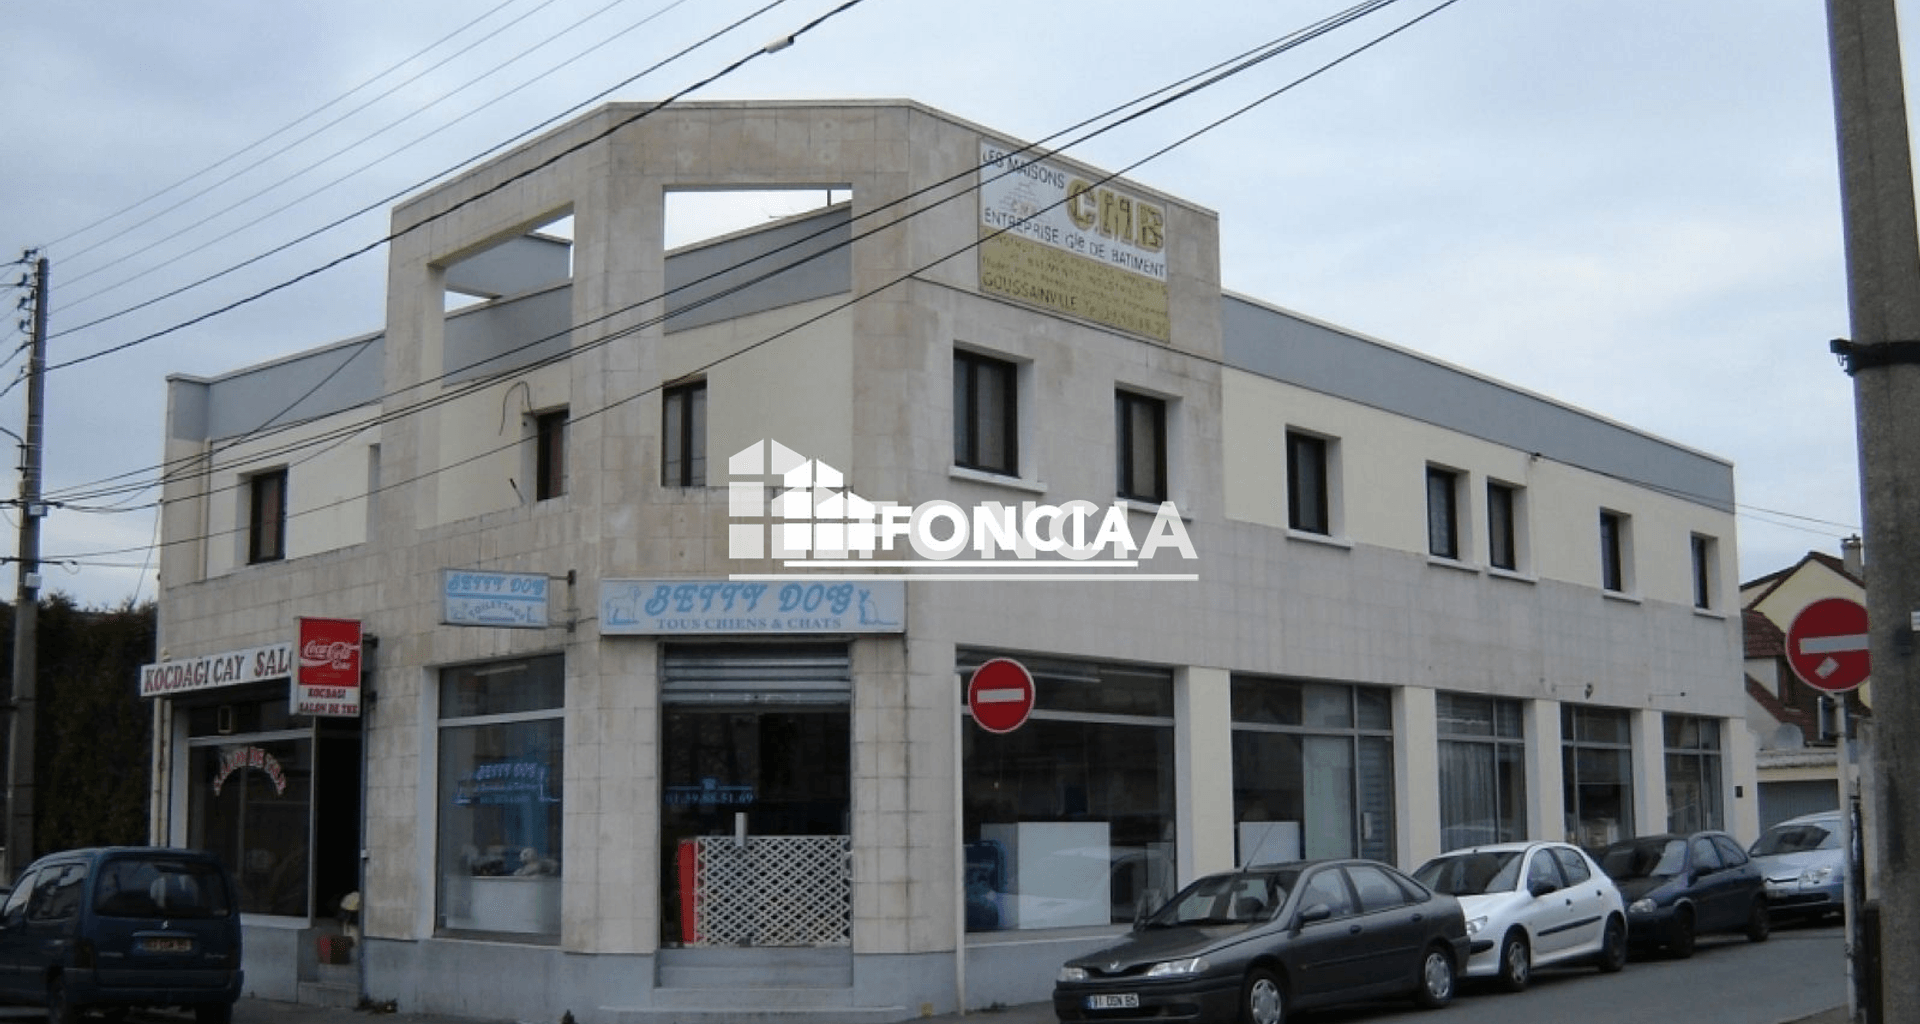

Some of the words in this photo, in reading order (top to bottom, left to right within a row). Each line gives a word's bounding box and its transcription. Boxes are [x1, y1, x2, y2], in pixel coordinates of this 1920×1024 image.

[1008, 157, 1065, 189] MAISONS
[984, 207, 1059, 243] ENTREPRISE
[1090, 242, 1105, 258] DE
[983, 276, 1076, 310] GOUSSAINVILLE
[447, 573, 506, 591] BETTY
[510, 577, 546, 595] DOG
[645, 583, 768, 616] BETTY
[778, 583, 854, 616] DOG
[656, 618, 703, 630] TOUS
[705, 618, 768, 630] CHIENS
[771, 618, 784, 629] &
[787, 617, 841, 629] CHATS
[254, 648, 292, 677] SAL
[328, 703, 339, 714] DE
